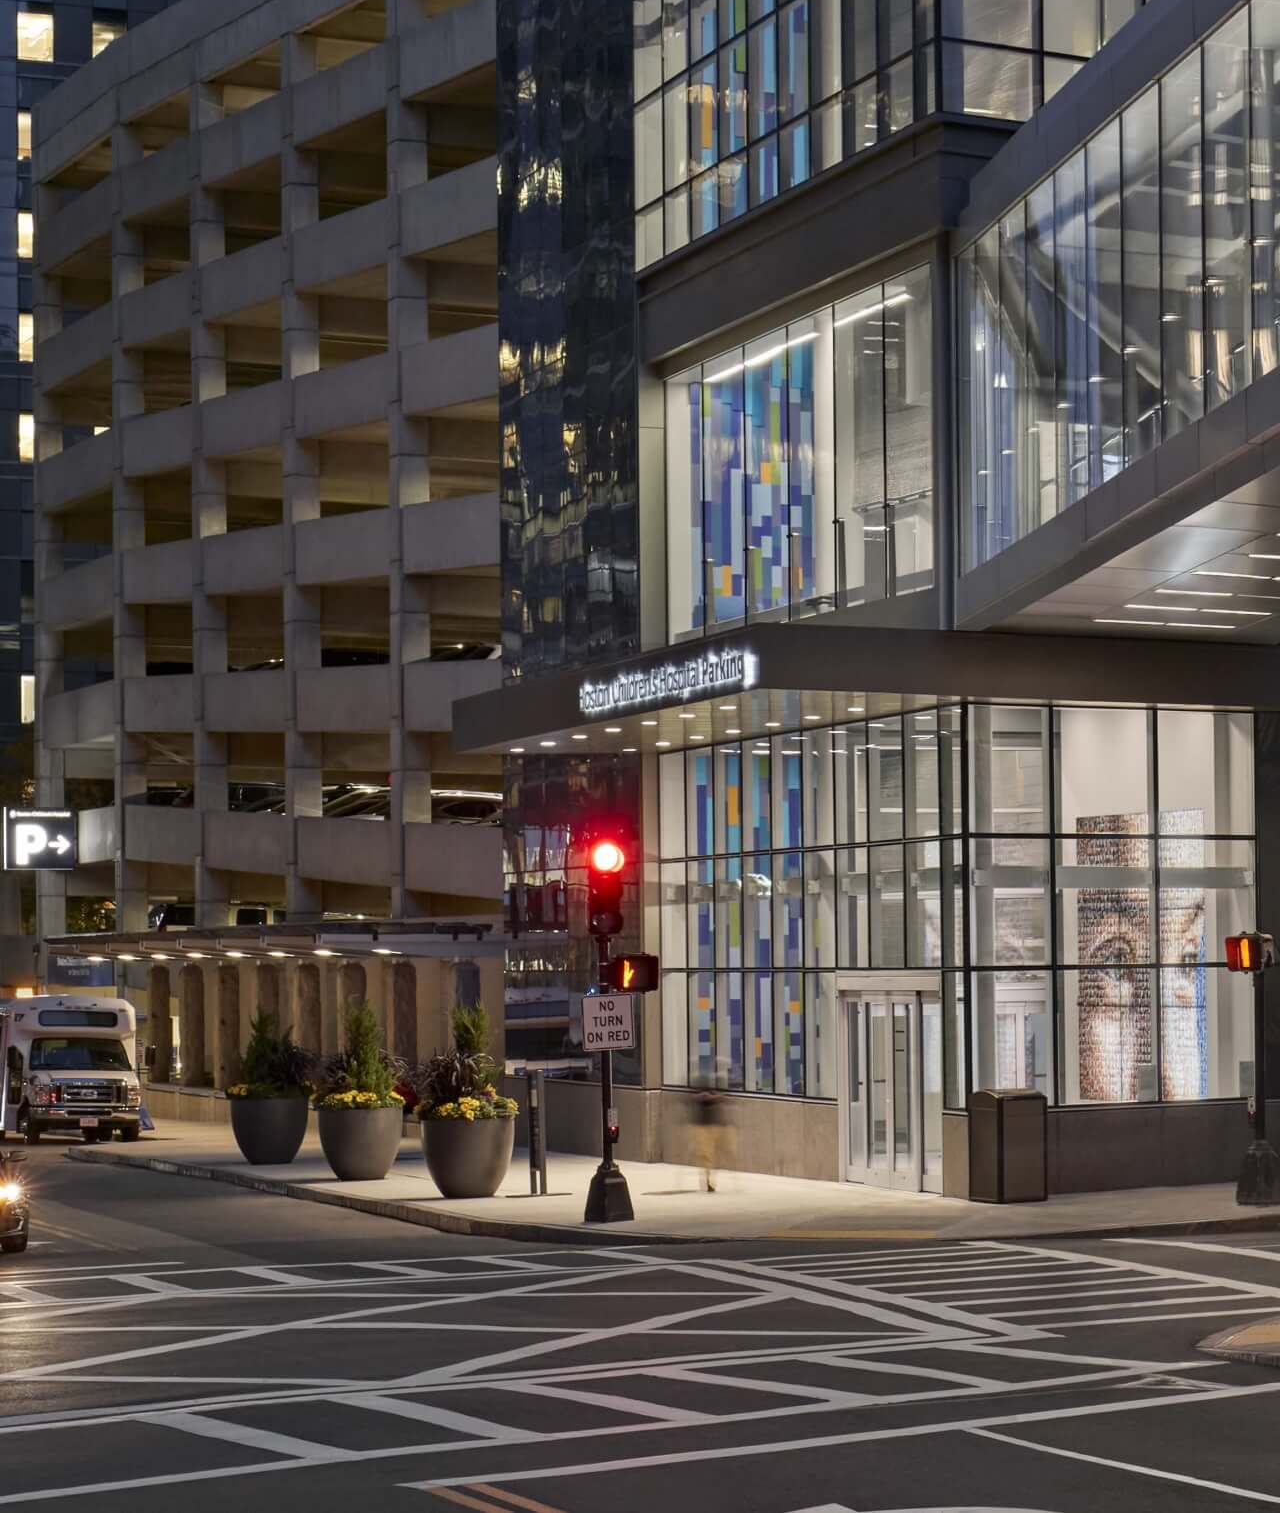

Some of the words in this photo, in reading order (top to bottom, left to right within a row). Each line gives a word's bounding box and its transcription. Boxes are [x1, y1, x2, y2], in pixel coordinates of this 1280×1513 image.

[580, 685, 610, 712] Boston
[612, 671, 657, 704] Children's
[659, 663, 700, 697] Hospital
[702, 653, 744, 685] Parking
[16, 824, 47, 865] P
[600, 1000, 615, 1012] NO
[592, 1015, 623, 1027] TURN
[587, 1031, 603, 1043] ON
[608, 1030, 630, 1041] RED
